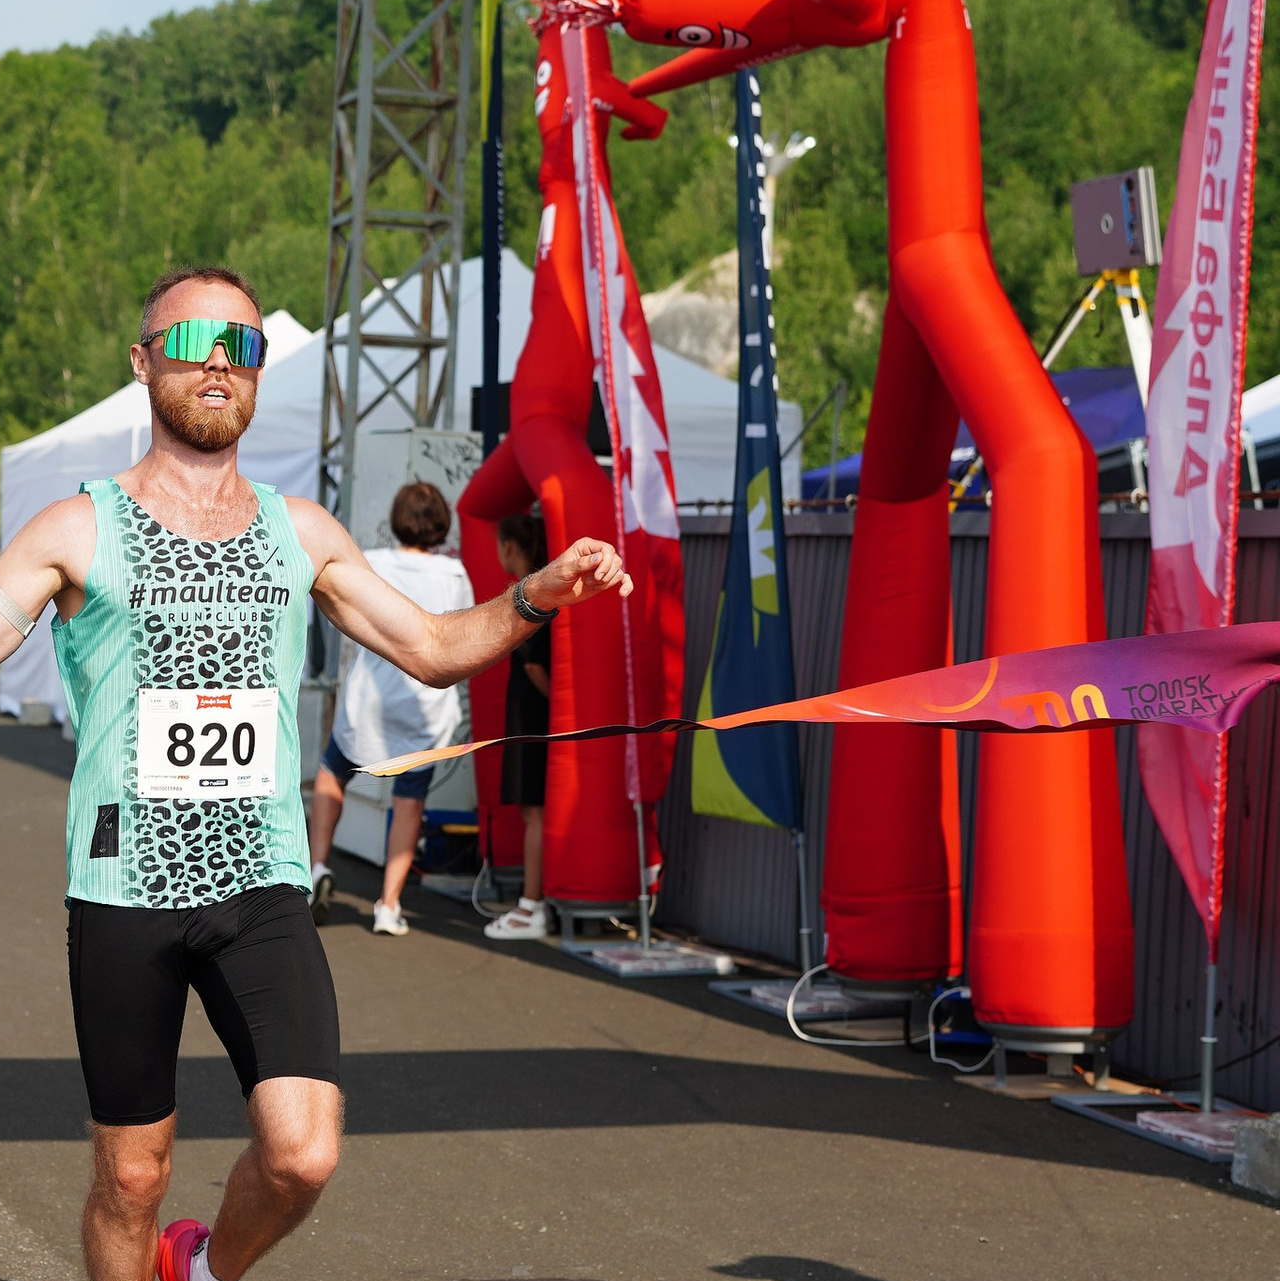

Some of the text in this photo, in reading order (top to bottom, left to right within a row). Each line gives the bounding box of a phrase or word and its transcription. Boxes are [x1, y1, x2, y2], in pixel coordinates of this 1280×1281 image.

[129, 580, 290, 609] #maulteam
[169, 612, 258, 623] RUN CLUB
[1122, 674, 1212, 706] TOMSK
[167, 722, 255, 767] 820
